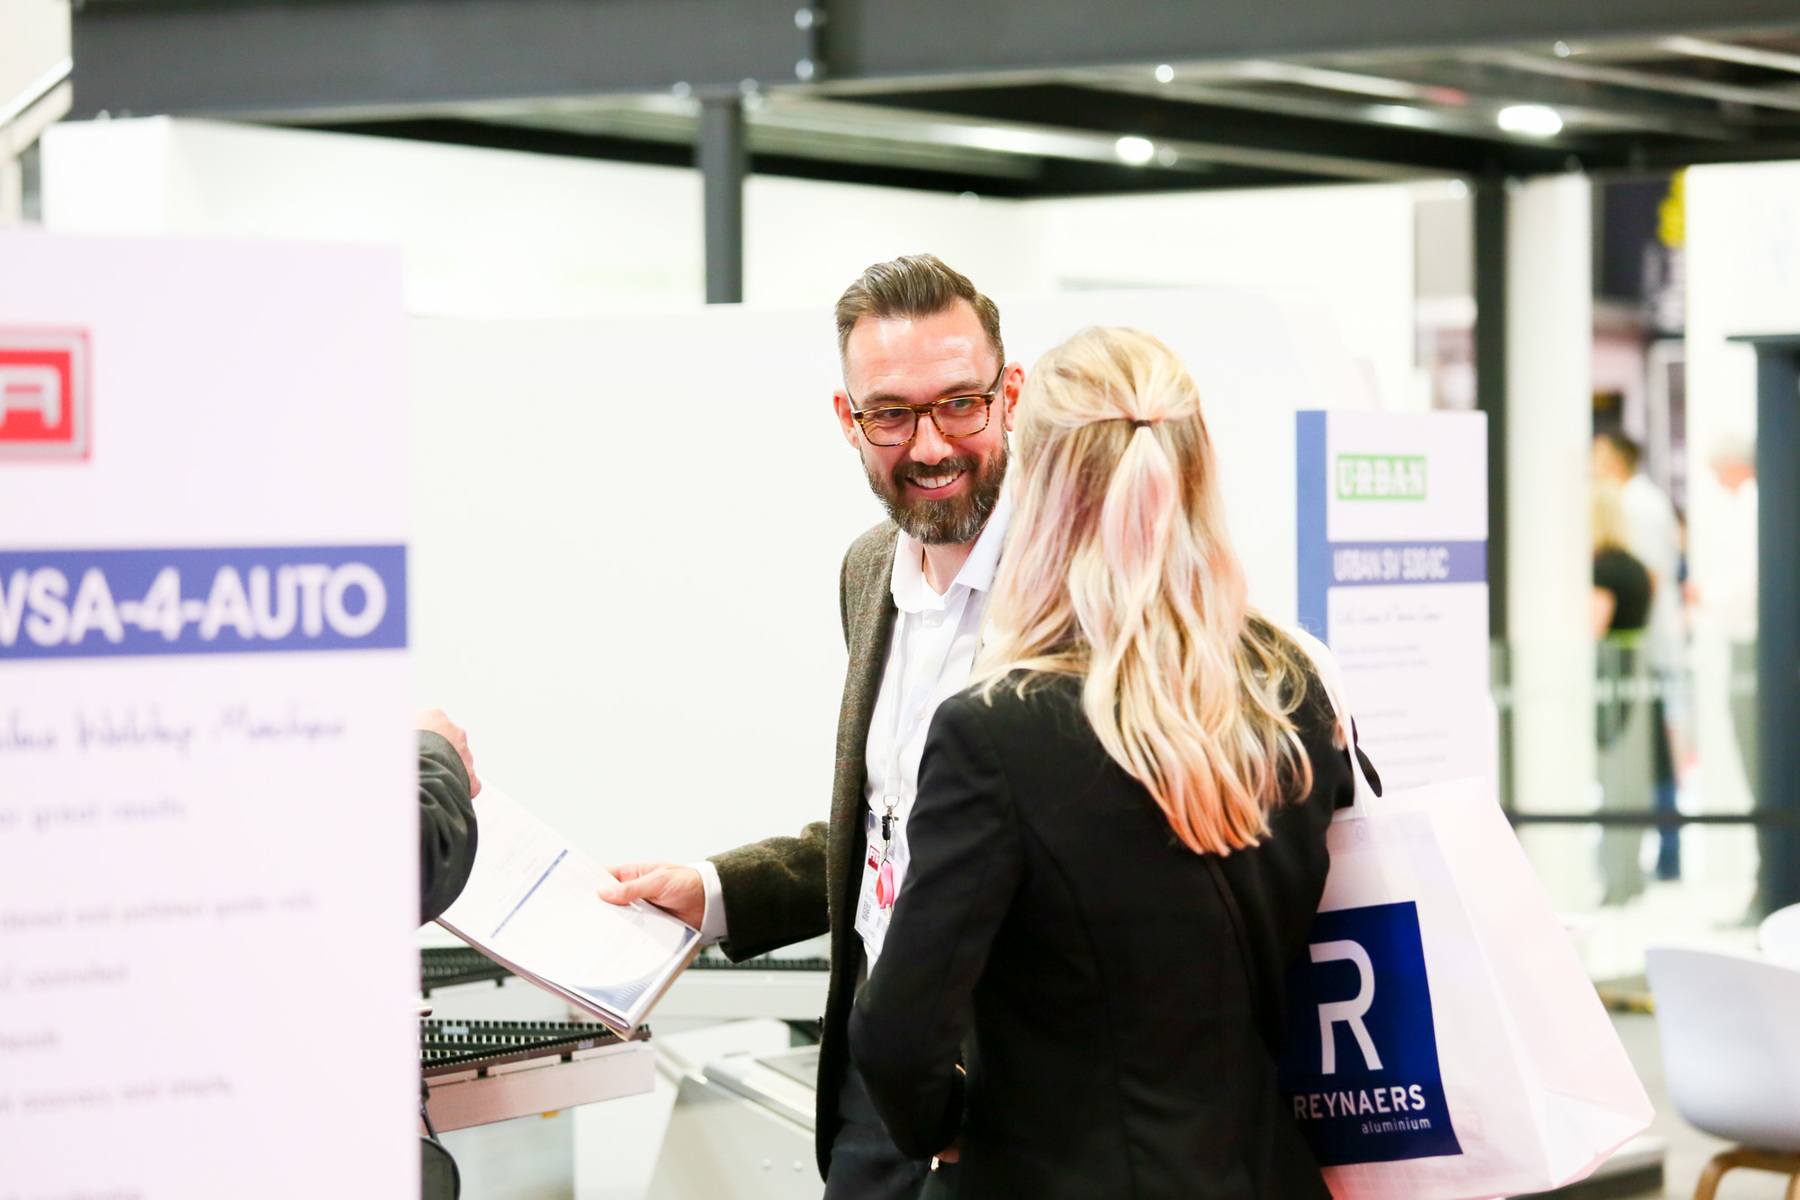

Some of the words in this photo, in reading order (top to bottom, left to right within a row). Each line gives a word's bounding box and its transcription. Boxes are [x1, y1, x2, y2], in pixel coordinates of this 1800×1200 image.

[1309, 939, 1384, 1075] R
[1294, 1084, 1426, 1119] REYNAERS
[1361, 1117, 1431, 1134] aluminium
